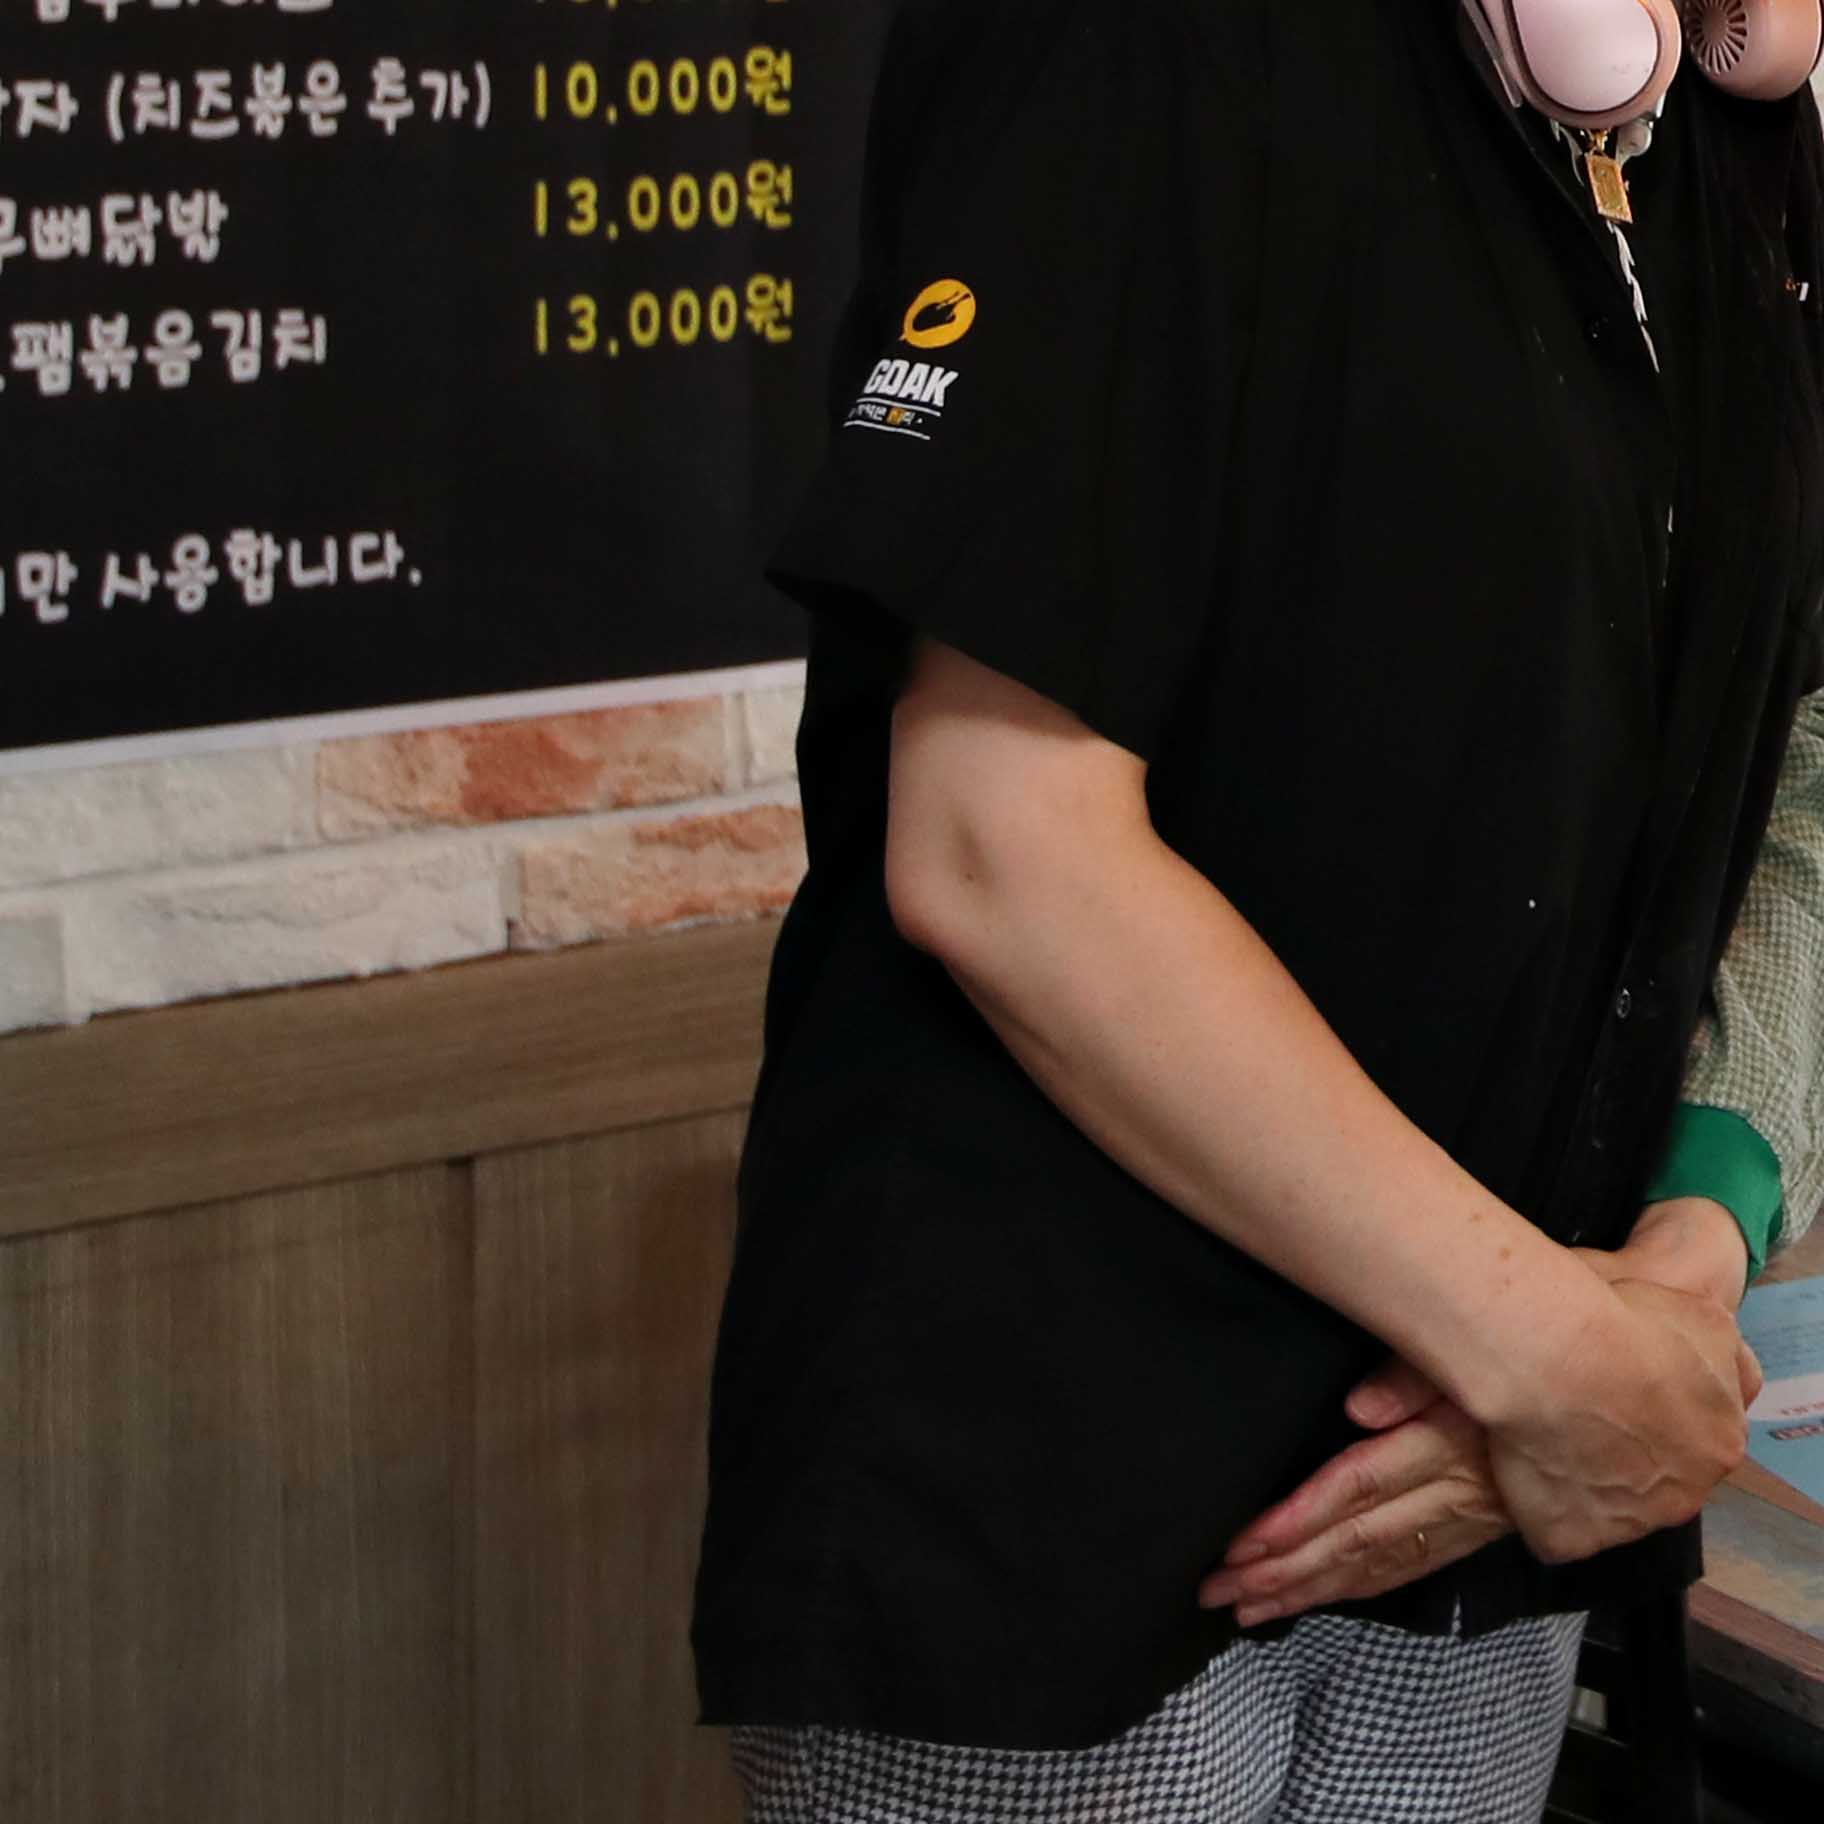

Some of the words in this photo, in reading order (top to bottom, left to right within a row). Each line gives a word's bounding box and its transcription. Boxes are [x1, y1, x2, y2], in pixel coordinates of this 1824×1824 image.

[0, 72, 80, 138] 자
[366, 57, 492, 136] 추가)
[535, 46, 792, 121] 10,000원
[534, 160, 793, 238] 13,000원
[0, 309, 328, 396] 팸볶음김치
[536, 274, 793, 354] 13,000원
[0, 551, 79, 623] 만
[100, 528, 423, 613] 사용합니다.
